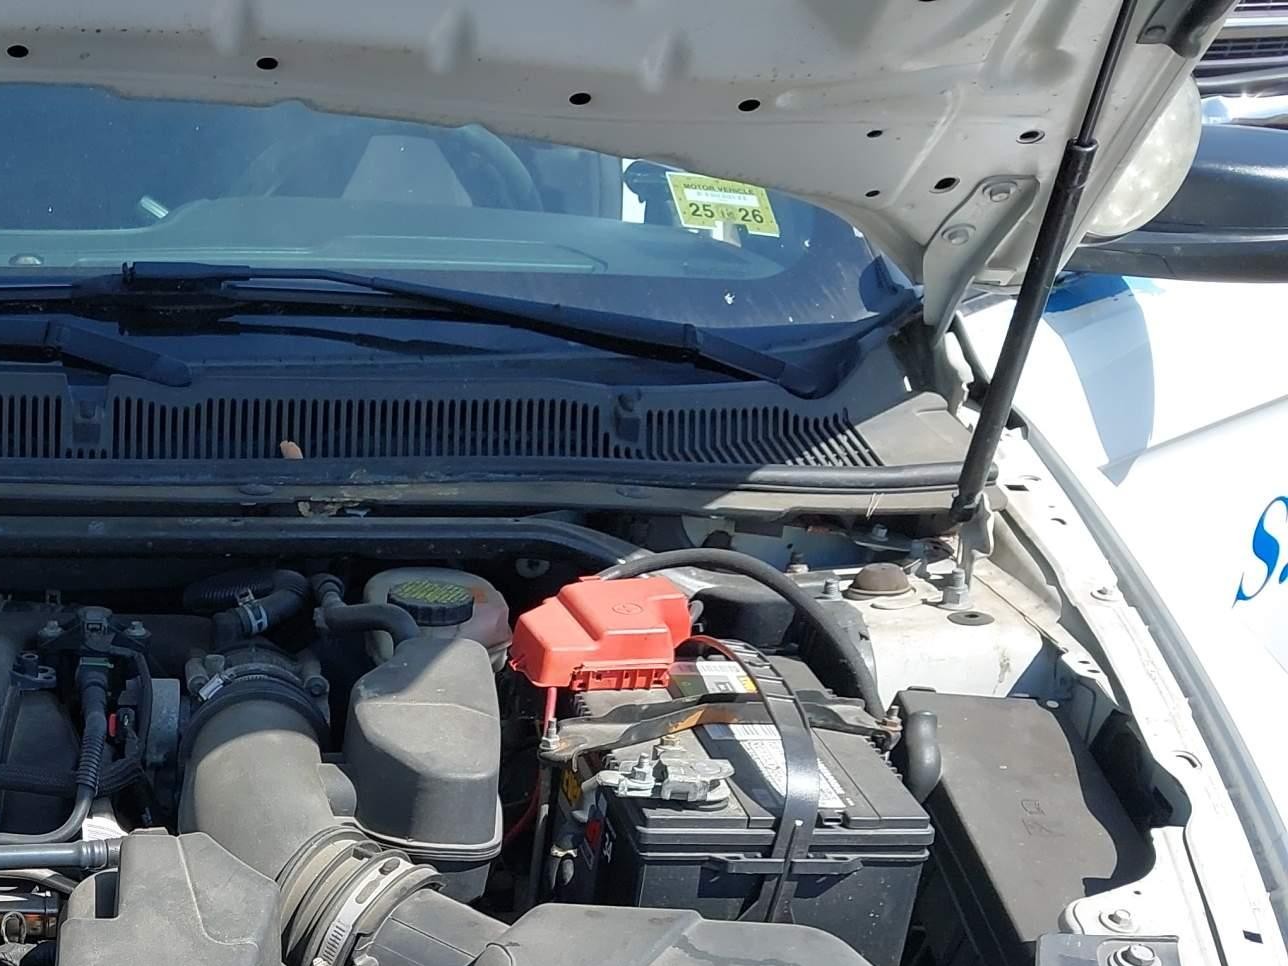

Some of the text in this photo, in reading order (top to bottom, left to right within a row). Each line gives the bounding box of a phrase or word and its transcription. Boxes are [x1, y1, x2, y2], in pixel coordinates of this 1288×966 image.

[683, 183, 754, 195] MOTOR VEHICLE
[689, 202, 715, 219] 25
[738, 207, 764, 224] 26
